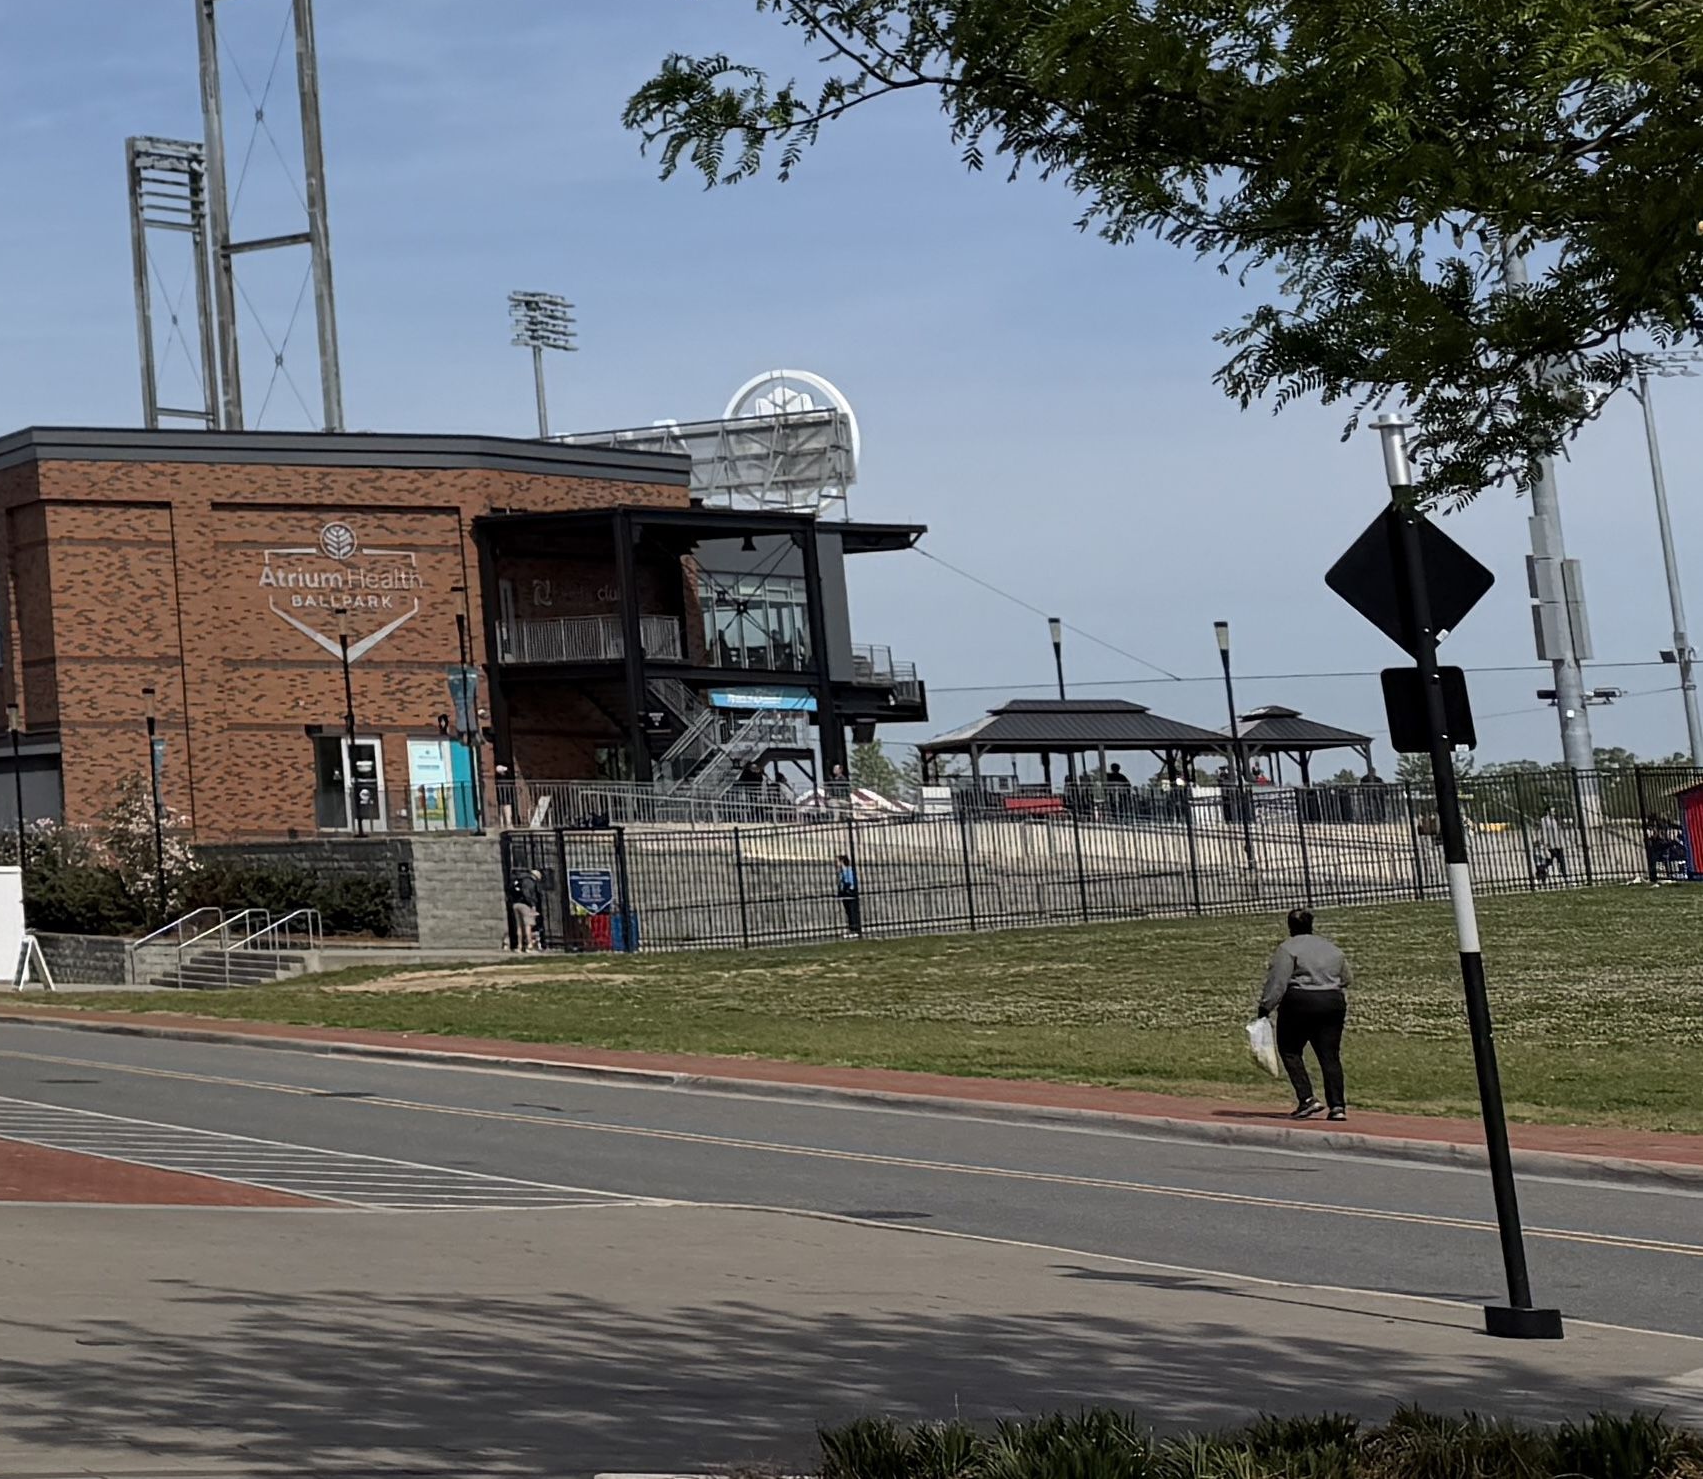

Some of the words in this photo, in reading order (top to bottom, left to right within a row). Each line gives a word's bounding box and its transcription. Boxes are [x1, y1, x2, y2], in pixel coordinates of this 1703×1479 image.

[258, 565, 343, 588] Atrium
[347, 567, 424, 589] Health
[291, 594, 393, 609] BALLPARK
